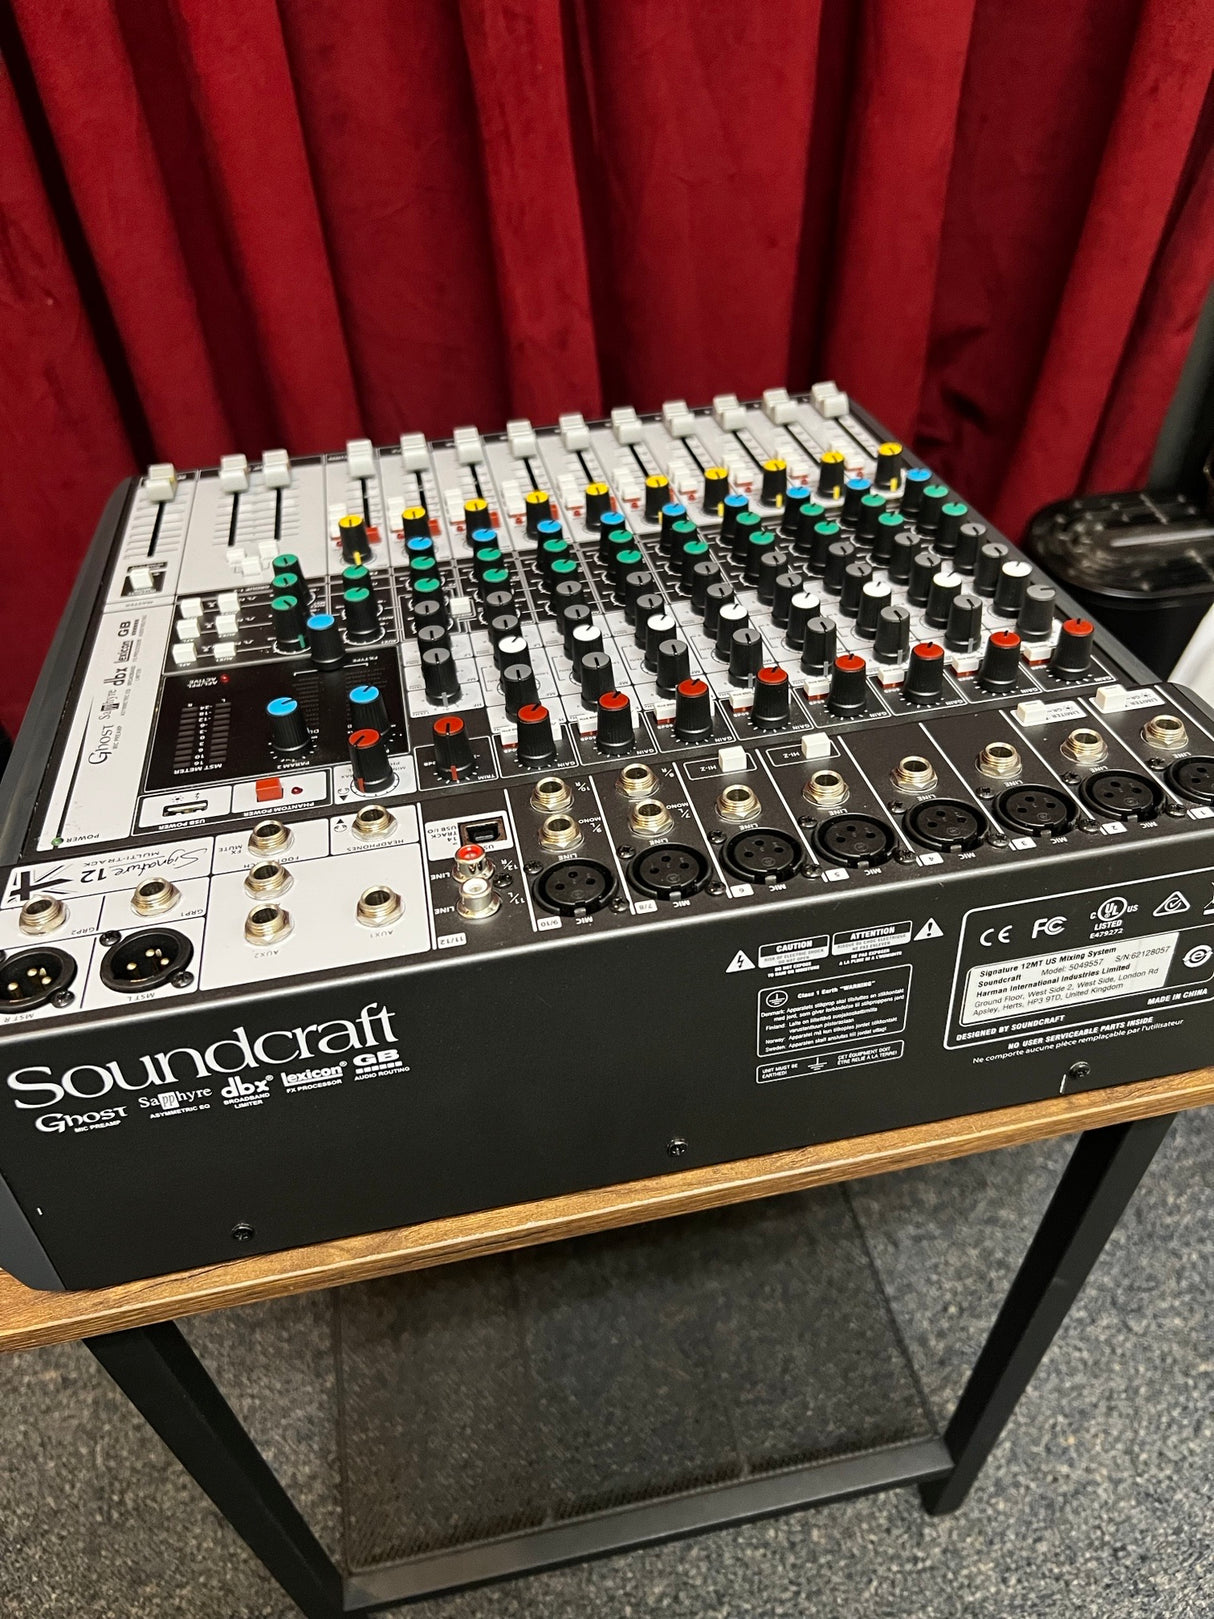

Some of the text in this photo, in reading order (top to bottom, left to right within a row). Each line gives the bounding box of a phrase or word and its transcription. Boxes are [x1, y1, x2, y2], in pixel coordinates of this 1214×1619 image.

[118, 620, 131, 637] GB
[1172, 751, 1192, 759] LINE
[173, 766, 203, 775] METER
[699, 764, 717, 772] HI-Z
[1088, 766, 1108, 774] LINE
[243, 802, 315, 817] PHANTOM POWER
[665, 802, 689, 811] MONO
[828, 808, 848, 816] LINE
[159, 818, 206, 830] USB POWER
[578, 816, 602, 824] MONO
[1140, 821, 1158, 829] MIC
[738, 822, 758, 830] LINE
[66, 833, 100, 843] POWER
[430, 831, 458, 839] TRACK
[1050, 836, 1068, 844] MIC
[346, 838, 404, 852] HEADPHONES
[648, 837, 668, 846] LINE
[218, 844, 242, 852] MUTE
[83, 850, 160, 868] MULTI-TRACK
[557, 852, 578, 861] LINE
[958, 852, 976, 860] MIC
[80, 848, 208, 884] Signature 12
[430, 872, 450, 881] LINE
[864, 868, 882, 876] MIC
[768, 883, 787, 892] MIC
[672, 900, 691, 908] MIC
[180, 908, 204, 917] GRP1
[434, 905, 455, 915] LINE
[540, 919, 559, 928] 9/10
[575, 916, 593, 925] MIC
[1094, 920, 1122, 931] LISTED
[71, 926, 95, 935] GRP2
[369, 930, 394, 938] AUX1
[850, 926, 896, 940] ATTENTION
[1090, 928, 1124, 939] E479272
[440, 936, 464, 946] 11/12
[776, 940, 813, 952] CAUTION
[253, 949, 279, 958] AUX2
[979, 946, 1117, 978] Signature 12MT US Mixing System
[978, 974, 1022, 988] Soundcraft
[1041, 965, 1067, 976] Model:
[1068, 958, 1104, 971] 5049557
[976, 962, 1131, 998] Harman International Industries Limited
[974, 996, 1002, 1008] Ground
[1004, 992, 1026, 1004] Floor,
[1028, 988, 1046, 998] West
[1048, 984, 1066, 995] Side
[1078, 979, 1096, 990] West
[1098, 975, 1116, 986] Side,
[1118, 970, 1146, 982] London
[1148, 968, 1159, 976] Rd
[135, 992, 155, 1000] MST
[798, 991, 814, 999] Class
[972, 1006, 1000, 1018] Apsley,
[1002, 1001, 1026, 1012] Herts,
[1028, 997, 1043, 1006] HP3
[1065, 988, 1089, 1000] United
[1091, 982, 1124, 996] Kingdom
[1147, 988, 1208, 1006] MADE IN CHINA
[12, 1013, 34, 1022] MST
[760, 1008, 786, 1018] Denmark:
[956, 1014, 1066, 1042] DESIGNED BY SOUNDCRAFT
[1007, 1016, 1154, 1050] NO USER SERVICEABLE PARTS INSIDE
[972, 1056, 984, 1064] Ne
[985, 1050, 1024, 1062] comporte
[1026, 1044, 1054, 1056] aucune
[1078, 1029, 1126, 1046] remplaçable
[1126, 1028, 1140, 1037] par
[1141, 1018, 1184, 1033] l'utilisateur
[7, 1002, 399, 1110] Soundcraft
[352, 1048, 400, 1067] GB
[354, 1066, 410, 1082] AUDIO ROUTING
[297, 1078, 342, 1092] PROCESSOR
[138, 1087, 213, 1110] Sapphyre
[223, 1092, 270, 1106] BROADBAND
[234, 1099, 264, 1109] LIMITER
[150, 1106, 198, 1120] ASYMMETRIC
[90, 1119, 122, 1130] PREAMP
